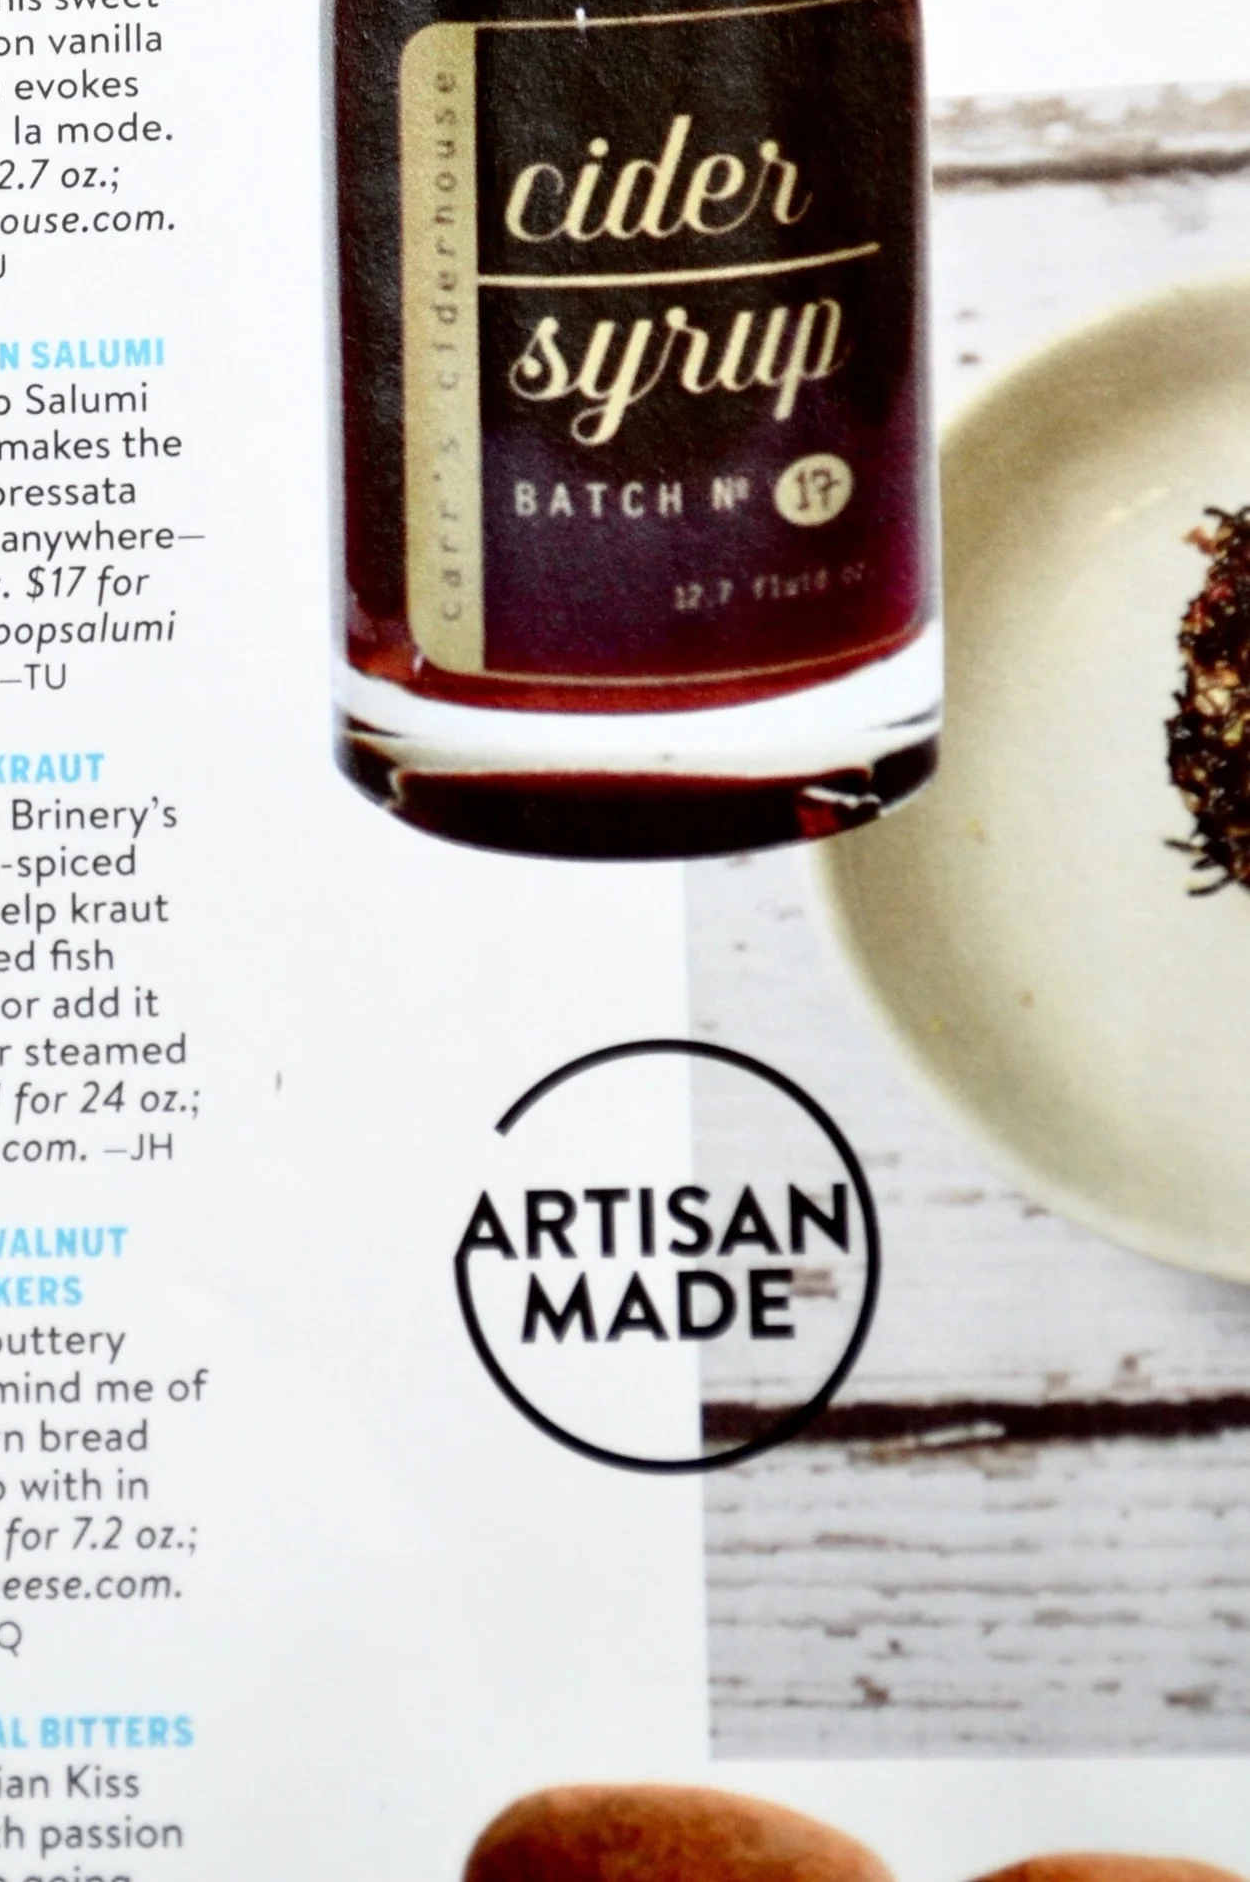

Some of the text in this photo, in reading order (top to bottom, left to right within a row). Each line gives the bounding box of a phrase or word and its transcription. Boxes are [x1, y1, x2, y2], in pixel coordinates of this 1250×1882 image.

[48, 21, 162, 55] vanilla
[14, 67, 139, 101] evokes
[15, 114, 41, 145] la
[58, 110, 172, 144] mode.
[61, 165, 119, 194] oz.;
[504, 115, 813, 245] cider
[31, 337, 164, 370] SALUMI
[509, 294, 852, 445] syrup
[513, 480, 684, 519] BATCH
[12, 795, 177, 839] Brinery’s
[71, 891, 169, 924] kraut
[49, 937, 114, 971] fish
[1, 996, 40, 1020] or
[53, 985, 119, 1019] add
[135, 985, 159, 1017] it
[25, 1031, 186, 1067] steamed
[15, 1080, 68, 1125] for
[80, 1079, 125, 1113] 24
[140, 1089, 199, 1118] oz.;
[457, 1181, 851, 1260] ARTISAN
[520, 1268, 796, 1345] MADE
[40, 1714, 194, 1748] BITTERS
[66, 1763, 140, 1798] Kiss
[40, 1814, 183, 1859] passion
